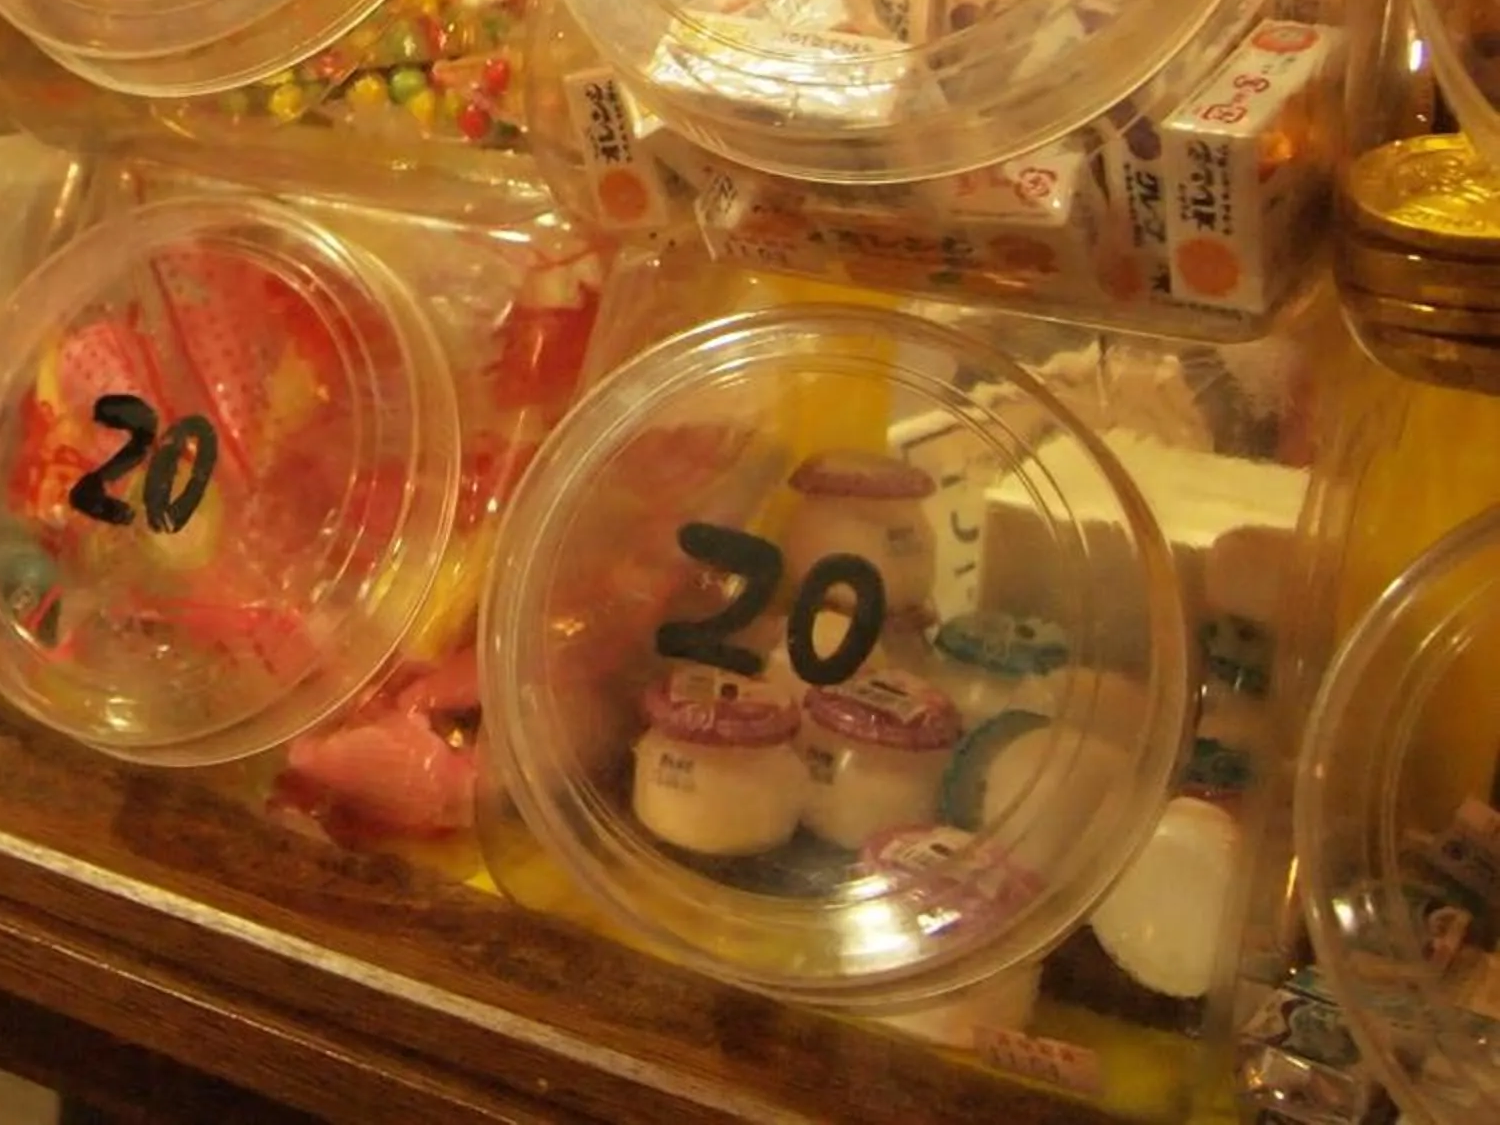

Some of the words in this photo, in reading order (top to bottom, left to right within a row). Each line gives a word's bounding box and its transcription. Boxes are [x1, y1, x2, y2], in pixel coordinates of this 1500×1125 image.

[1188, 139, 1217, 231] オレンジ
[68, 393, 220, 535] 20
[656, 521, 887, 686] 20
